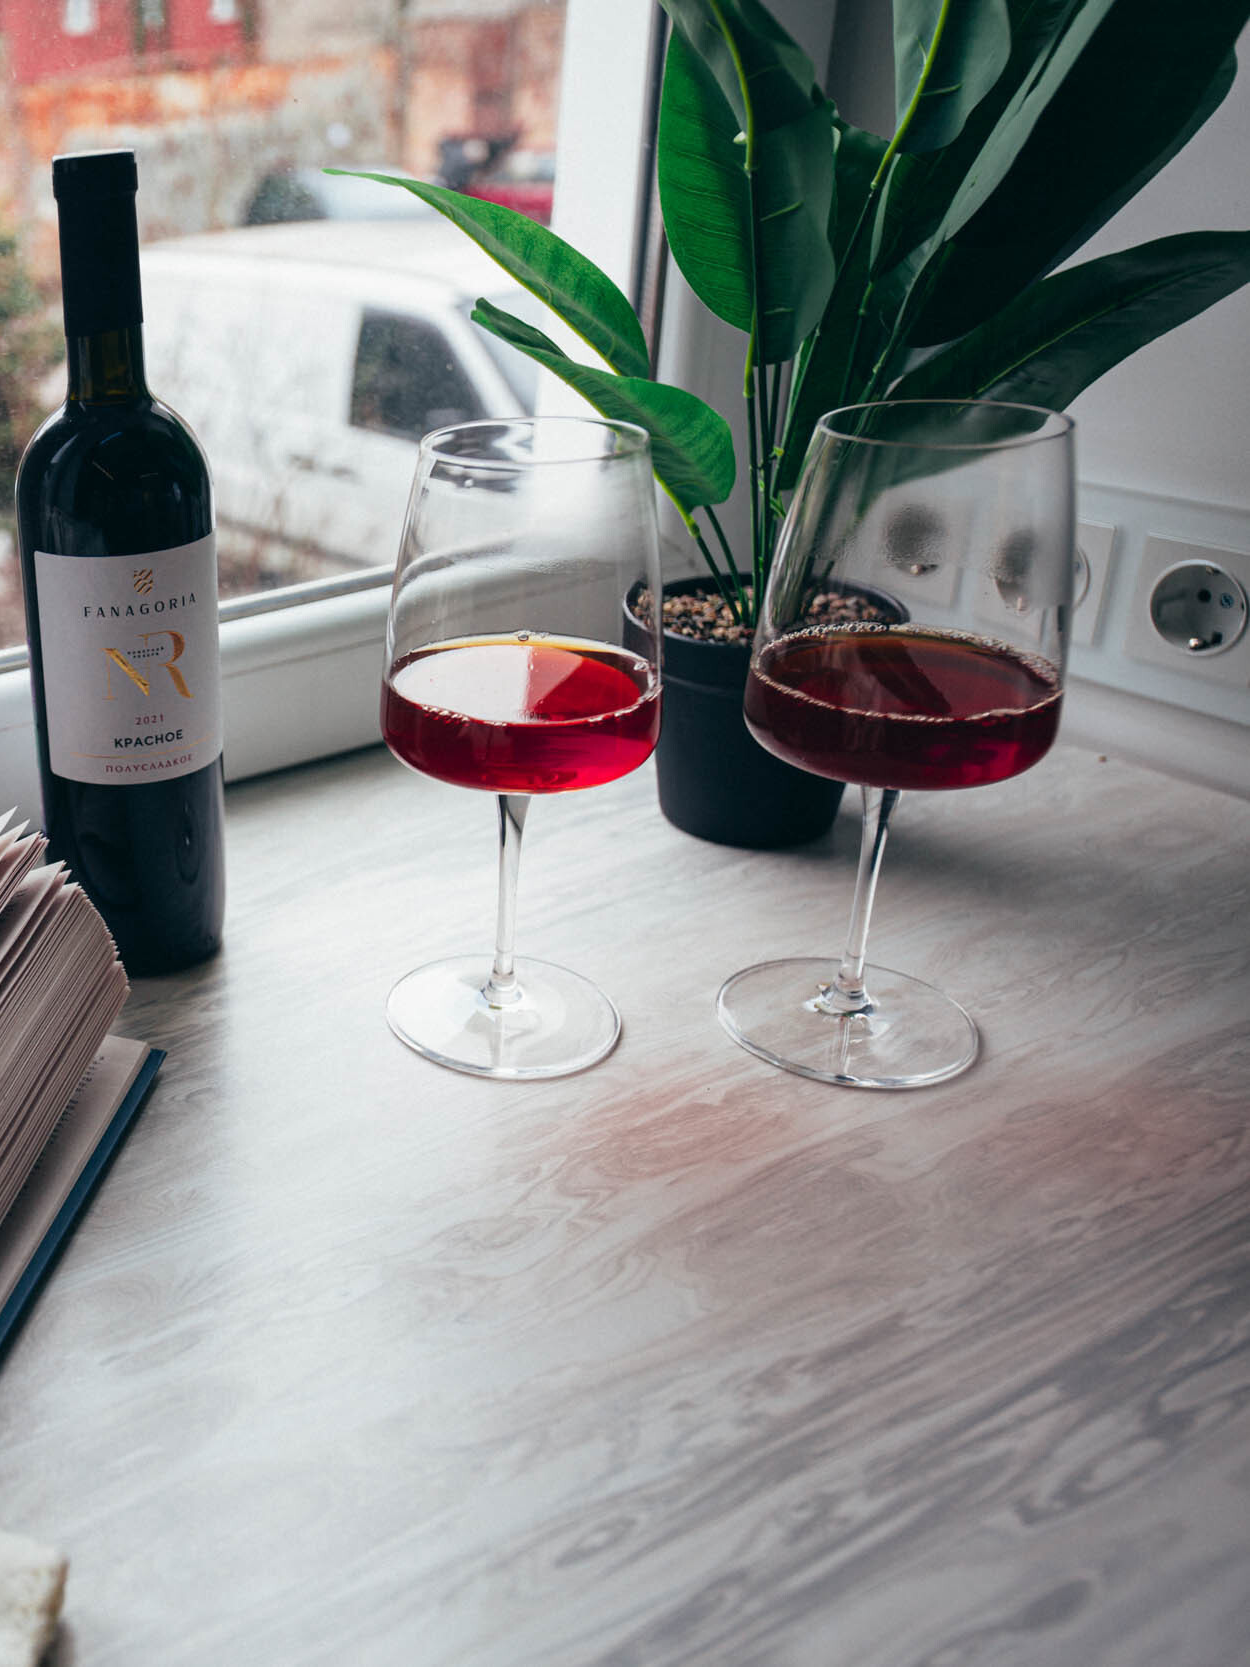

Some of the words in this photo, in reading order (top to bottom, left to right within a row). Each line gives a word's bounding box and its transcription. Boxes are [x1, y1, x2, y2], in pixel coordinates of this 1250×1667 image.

[84, 593, 197, 618] FANAGORIA
[134, 714, 165, 726] 2021
[114, 729, 184, 749] КРАСНОЕ
[105, 753, 193, 774] ПОЛУСЛАДКОЕ
